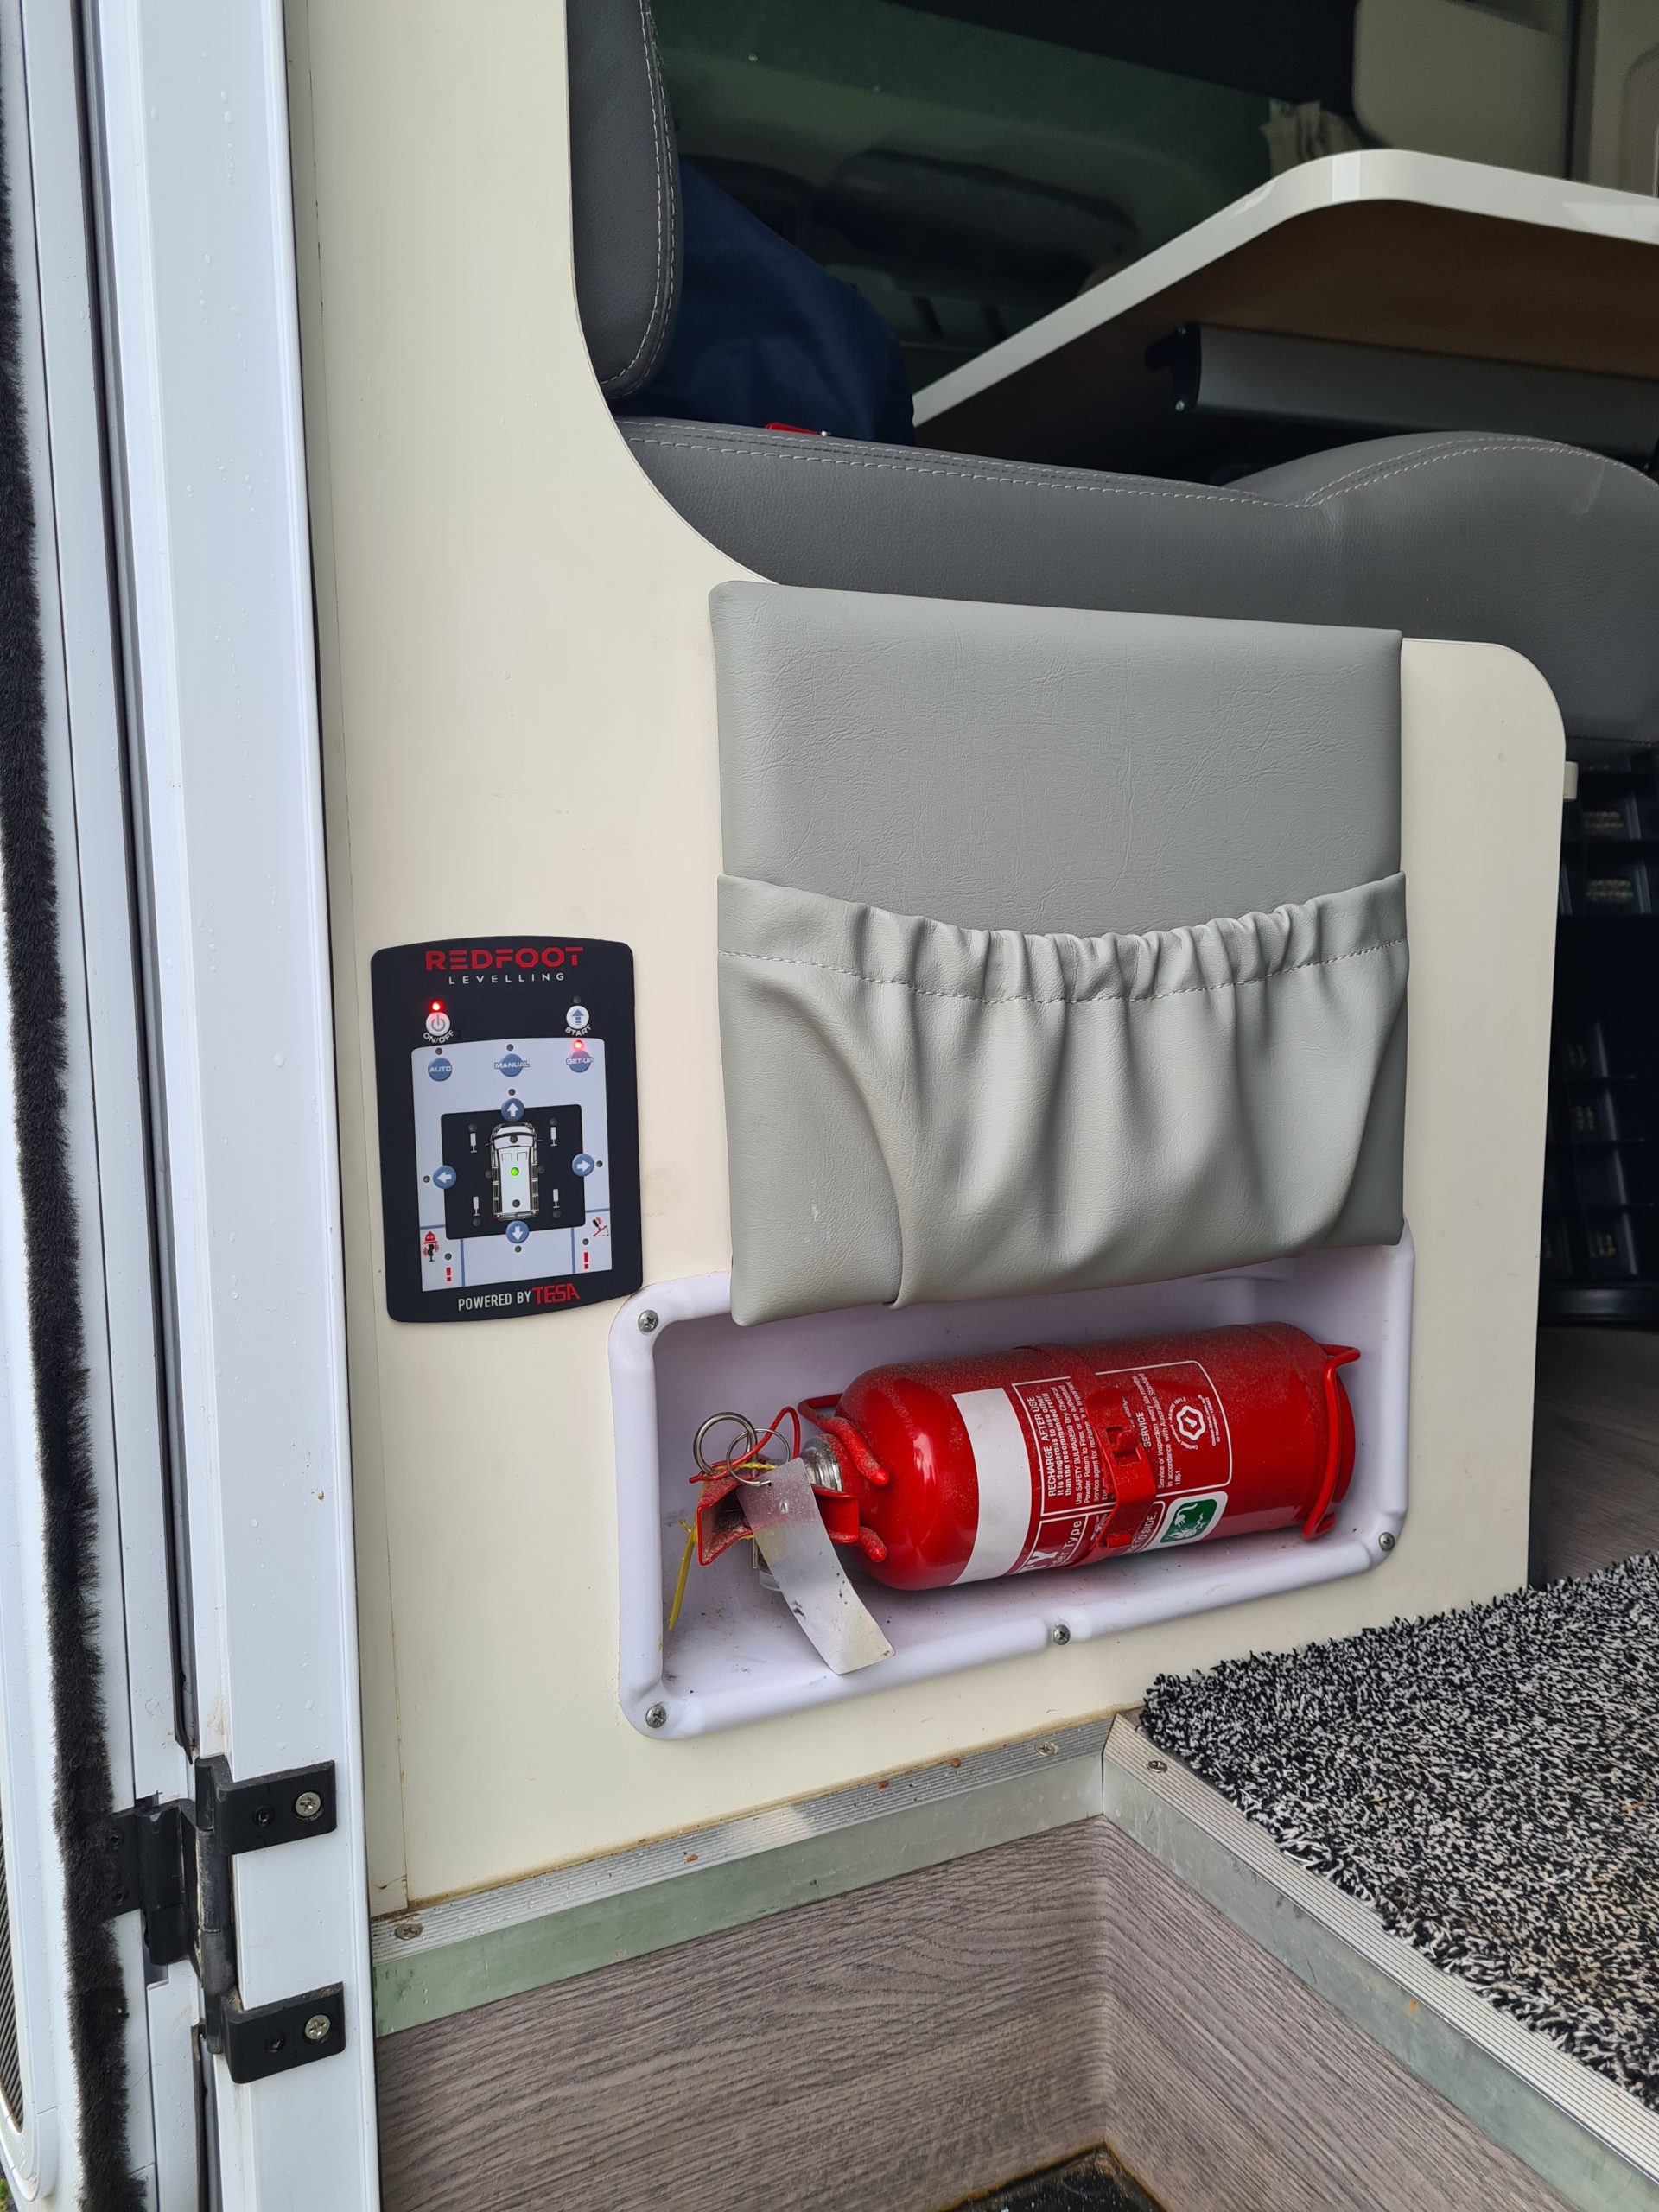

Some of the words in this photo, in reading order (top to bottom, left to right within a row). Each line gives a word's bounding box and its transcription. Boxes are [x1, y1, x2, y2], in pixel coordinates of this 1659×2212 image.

[425, 946, 584, 971] REDFOOT
[448, 972, 565, 985] LEVELLING
[423, 1029, 454, 1044] ON/OFF
[565, 1025, 593, 1037] START
[458, 1293, 512, 1311] POWERED
[517, 1291, 531, 1304] BY
[531, 1283, 580, 1305] TESA
[1132, 1376, 1146, 1395] months
[1137, 1373, 1155, 1396] Standard
[1027, 1396, 1039, 1412] USE
[1036, 1395, 1047, 1413] other
[1041, 1393, 1054, 1408] refill
[1050, 1386, 1066, 1411] Chemical
[1045, 1414, 1053, 1427] use
[1063, 1412, 1071, 1423] Dry
[1147, 1405, 1156, 1421] every
[1153, 1396, 1166, 1427] Australian
[1034, 1414, 1050, 1441] AFTER
[1049, 1409, 1070, 1463] recommended
[1135, 1411, 1152, 1447] SERVICE
[1153, 1423, 1163, 1455] inspection
[1052, 1438, 1063, 1479] dangerous
[1092, 1460, 1101, 1478] agent
[1044, 1446, 1057, 1497] RECHARGE
[1062, 1520, 1082, 1549] Type
[1134, 1535, 1147, 1544] TO
[1141, 1512, 1157, 1534] SIDE.
